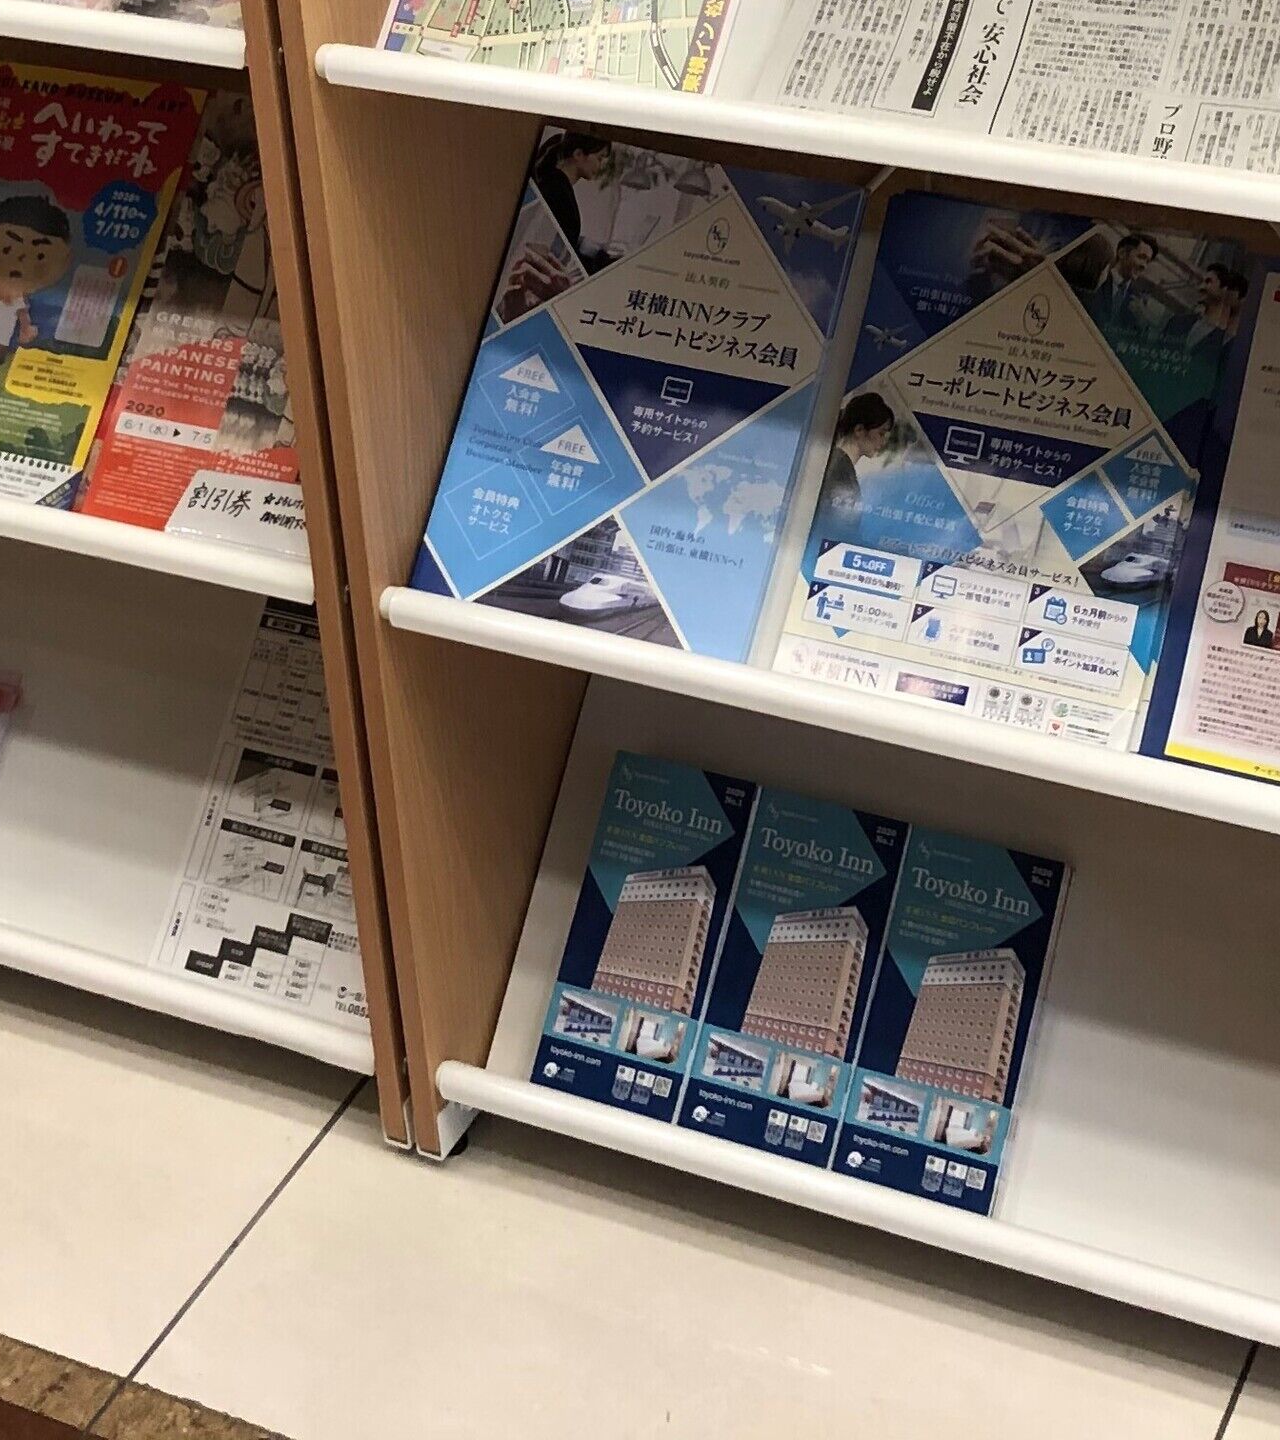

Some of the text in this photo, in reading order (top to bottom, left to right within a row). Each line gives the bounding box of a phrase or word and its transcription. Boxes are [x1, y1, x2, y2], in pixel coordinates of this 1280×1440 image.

[680, 18, 717, 93] 東横イン
[32, 103, 168, 146] へいわって
[1152, 104, 1179, 159] プロ野
[30, 131, 159, 177] すてきだね
[626, 288, 772, 333] 東横INNクラブ
[577, 307, 800, 372] コーポレートビジネス会員
[139, 356, 227, 386] PAINTING
[516, 366, 547, 383] FREE
[957, 354, 1097, 394] 東横INNクラブ
[124, 400, 166, 418] 2020
[505, 385, 542, 404] 入会金
[907, 370, 1133, 430] コーポレートビジネス会員
[632, 405, 709, 431] 専用サイトからの
[556, 439, 587, 455] FREE
[550, 459, 585, 479] 年会費
[185, 485, 252, 518] 割引券
[470, 503, 513, 522] オトクな
[471, 486, 520, 510] 会員特典
[466, 515, 510, 535] サービス
[649, 523, 706, 545] 国内・海外の
[614, 788, 723, 835] Toyoko Inn
[761, 826, 874, 877] Toyoko Inn
[911, 865, 1032, 918] Toyoko Inn
